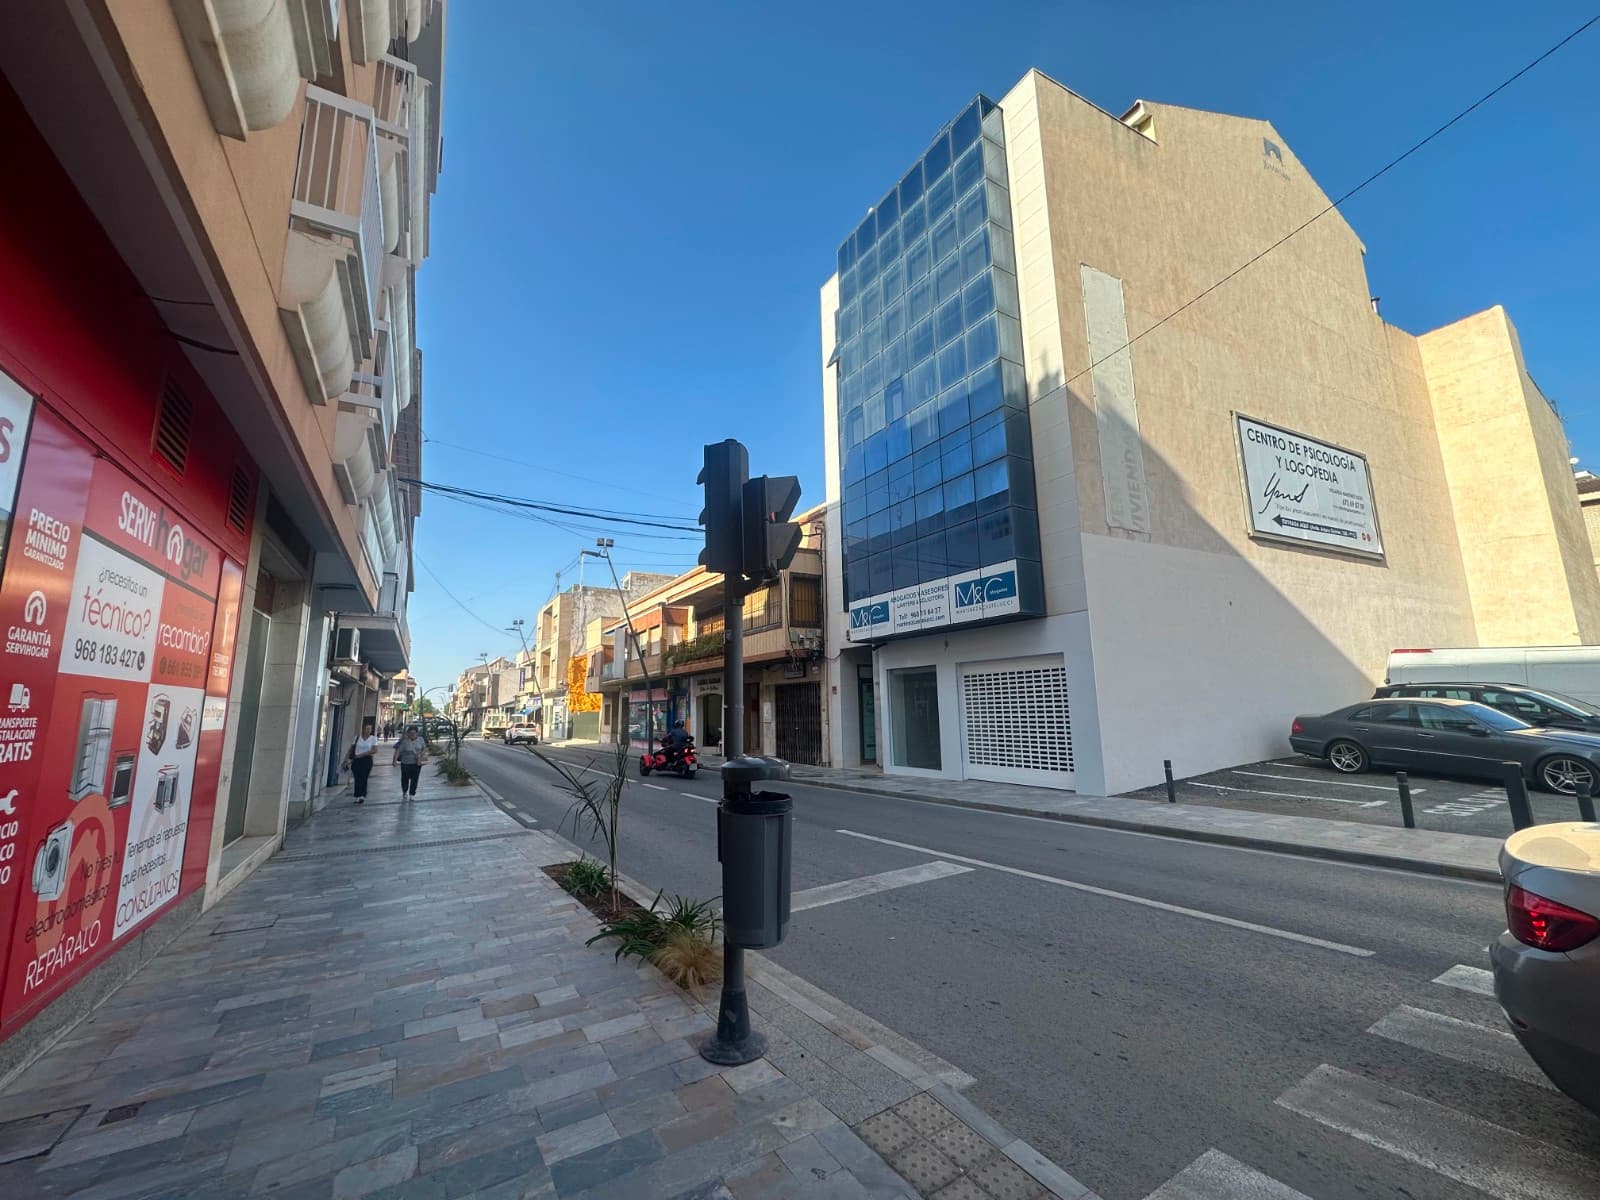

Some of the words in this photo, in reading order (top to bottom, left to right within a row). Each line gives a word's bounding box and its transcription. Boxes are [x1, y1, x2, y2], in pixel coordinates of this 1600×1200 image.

[1247, 428, 1286, 450] CENTRO
[1289, 441, 1301, 455] DE
[1303, 444, 1356, 472] PSICOLOGÍA
[1275, 455, 1282, 469] Y
[1285, 458, 1339, 485] LOGOPEDIA
[30, 508, 70, 542] PRECIO
[24, 546, 64, 570] GARANTIZADO
[25, 529, 67, 560] MINIMO
[138, 585, 148, 598] un
[956, 577, 1003, 609] M&C
[82, 586, 151, 639] técnico?
[5, 641, 49, 658] SERVIHOGAR
[8, 626, 51, 646] GARANTÍA
[74, 638, 97, 661] 968
[100, 643, 118, 664] 183
[119, 647, 138, 668] 427
[122, 870, 137, 888] que
[24, 919, 101, 995] REPÁRALO
